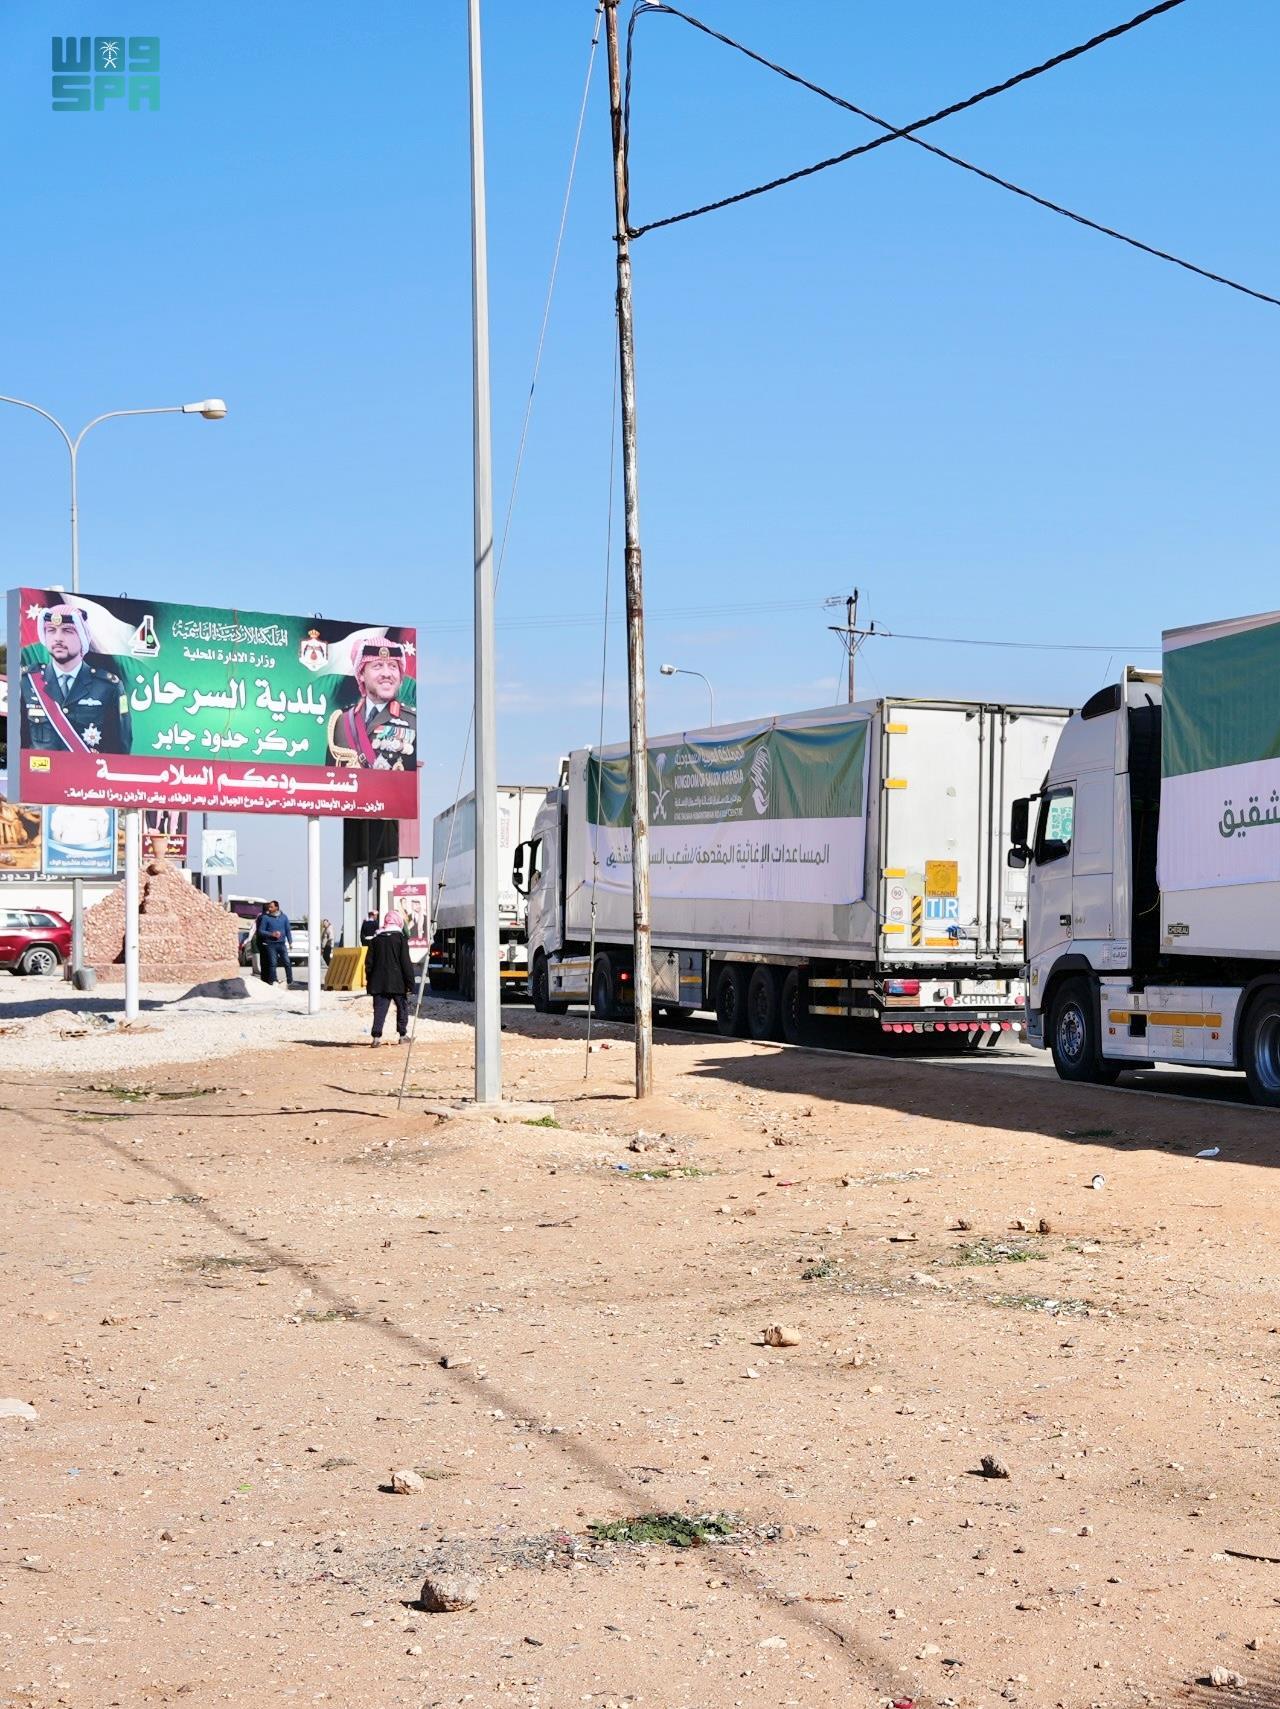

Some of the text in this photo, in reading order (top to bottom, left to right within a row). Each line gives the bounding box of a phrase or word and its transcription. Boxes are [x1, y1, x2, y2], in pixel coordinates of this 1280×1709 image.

[183, 647, 215, 661] المحلية
[249, 652, 276, 668] وزارة
[130, 671, 327, 725] بلدية السرحان
[152, 723, 310, 757] مركز حدود جابر
[95, 758, 214, 786] السلامة
[771, 844, 830, 864] المساعدات
[927, 898, 958, 918] TIR
